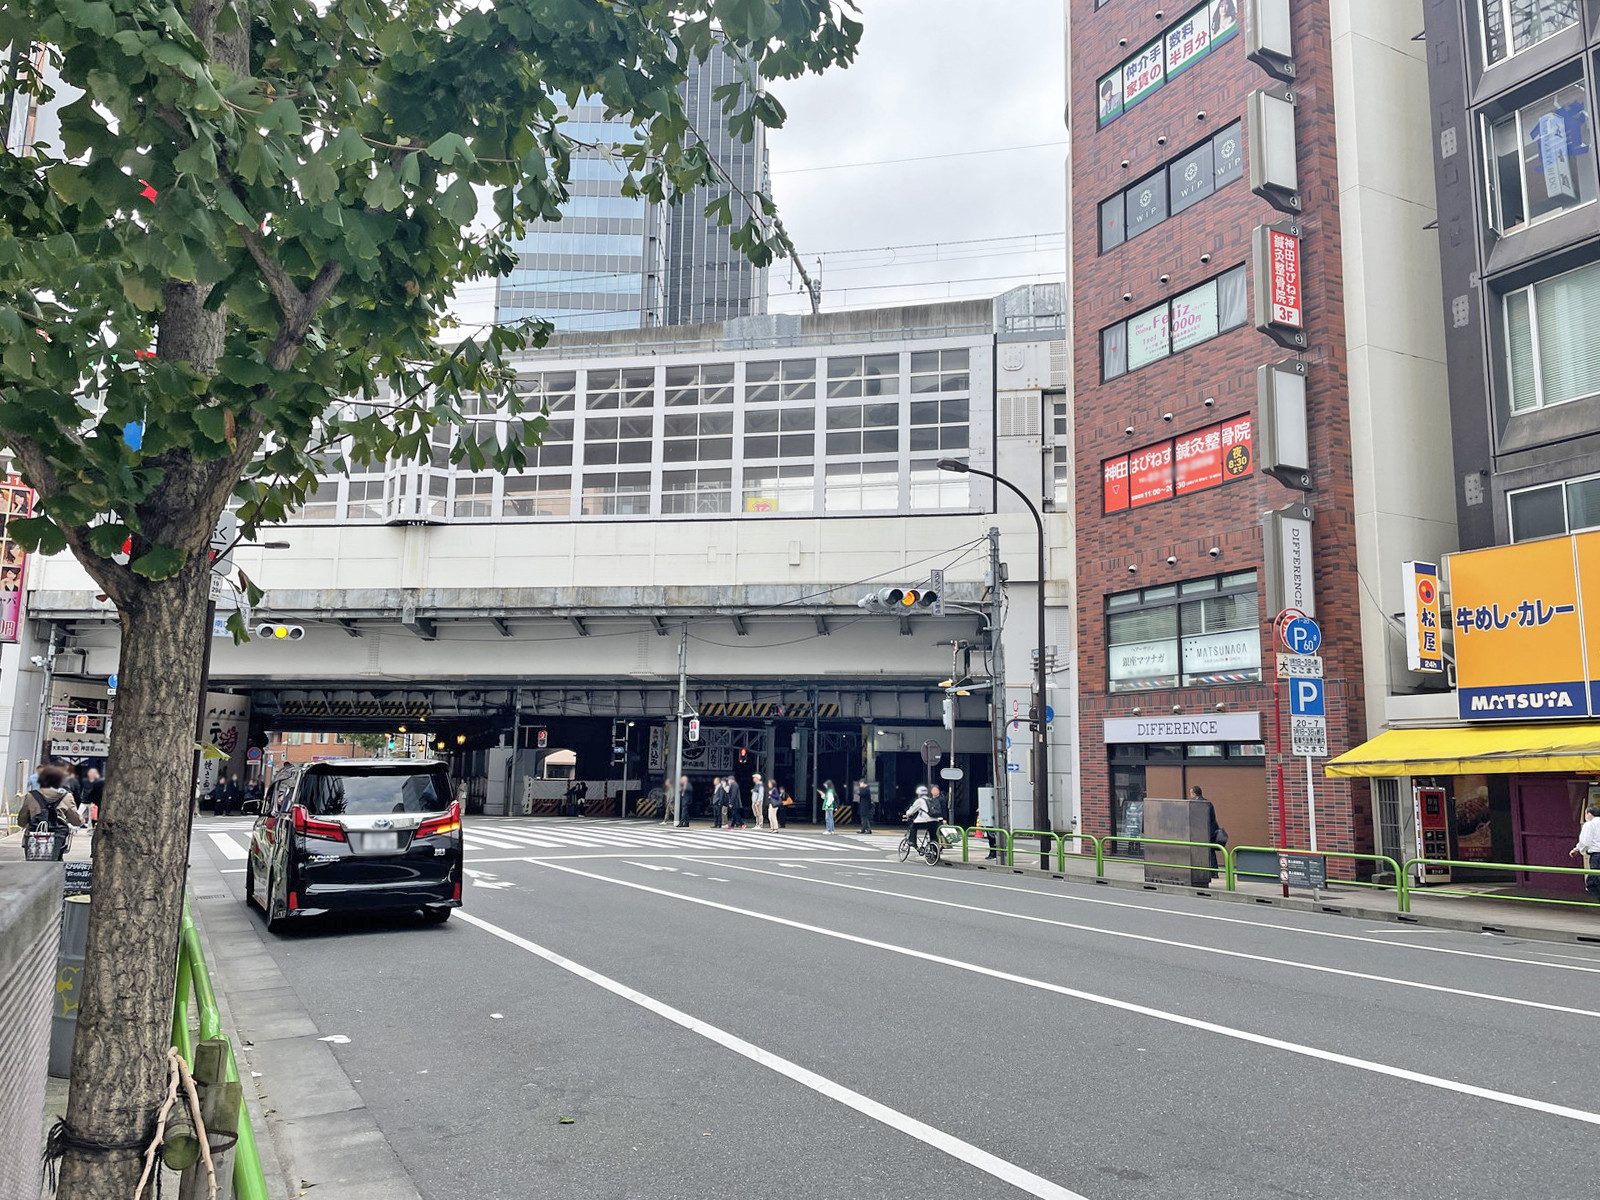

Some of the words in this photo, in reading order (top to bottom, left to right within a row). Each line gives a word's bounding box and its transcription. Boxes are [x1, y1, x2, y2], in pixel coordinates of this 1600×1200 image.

[1126, 20, 1193, 80] 仲介手数料
[1126, 31, 1207, 98] 家賃の半月分
[1216, 157, 1241, 176] WIP
[1180, 180, 1203, 197] WIP
[1136, 206, 1157, 223] WIP
[1274, 234, 1286, 304] 鍼灸整骨院
[1284, 238, 1297, 306] 神田はぴねす
[1279, 307, 1293, 322] 3F
[1105, 447, 1172, 482] 神田はぴねす
[1175, 421, 1251, 460] 鍼灸整骨院
[1232, 446, 1243, 458] 夜
[1228, 456, 1247, 468] 8:30
[1292, 528, 1303, 607] DIFFERENCE
[1456, 599, 1575, 634] 牛めし・カレー
[1421, 607, 1436, 651] 松屋
[1294, 627, 1307, 650] P
[1304, 640, 1314, 651] 60
[1196, 643, 1247, 658] MATSUNAGA
[1122, 653, 1165, 667] 銀座マツナガ
[1424, 660, 1437, 668] 24h
[1298, 681, 1318, 711] P
[1137, 721, 1218, 736] DIFFERENCE
[1296, 719, 1319, 727] 20-7
